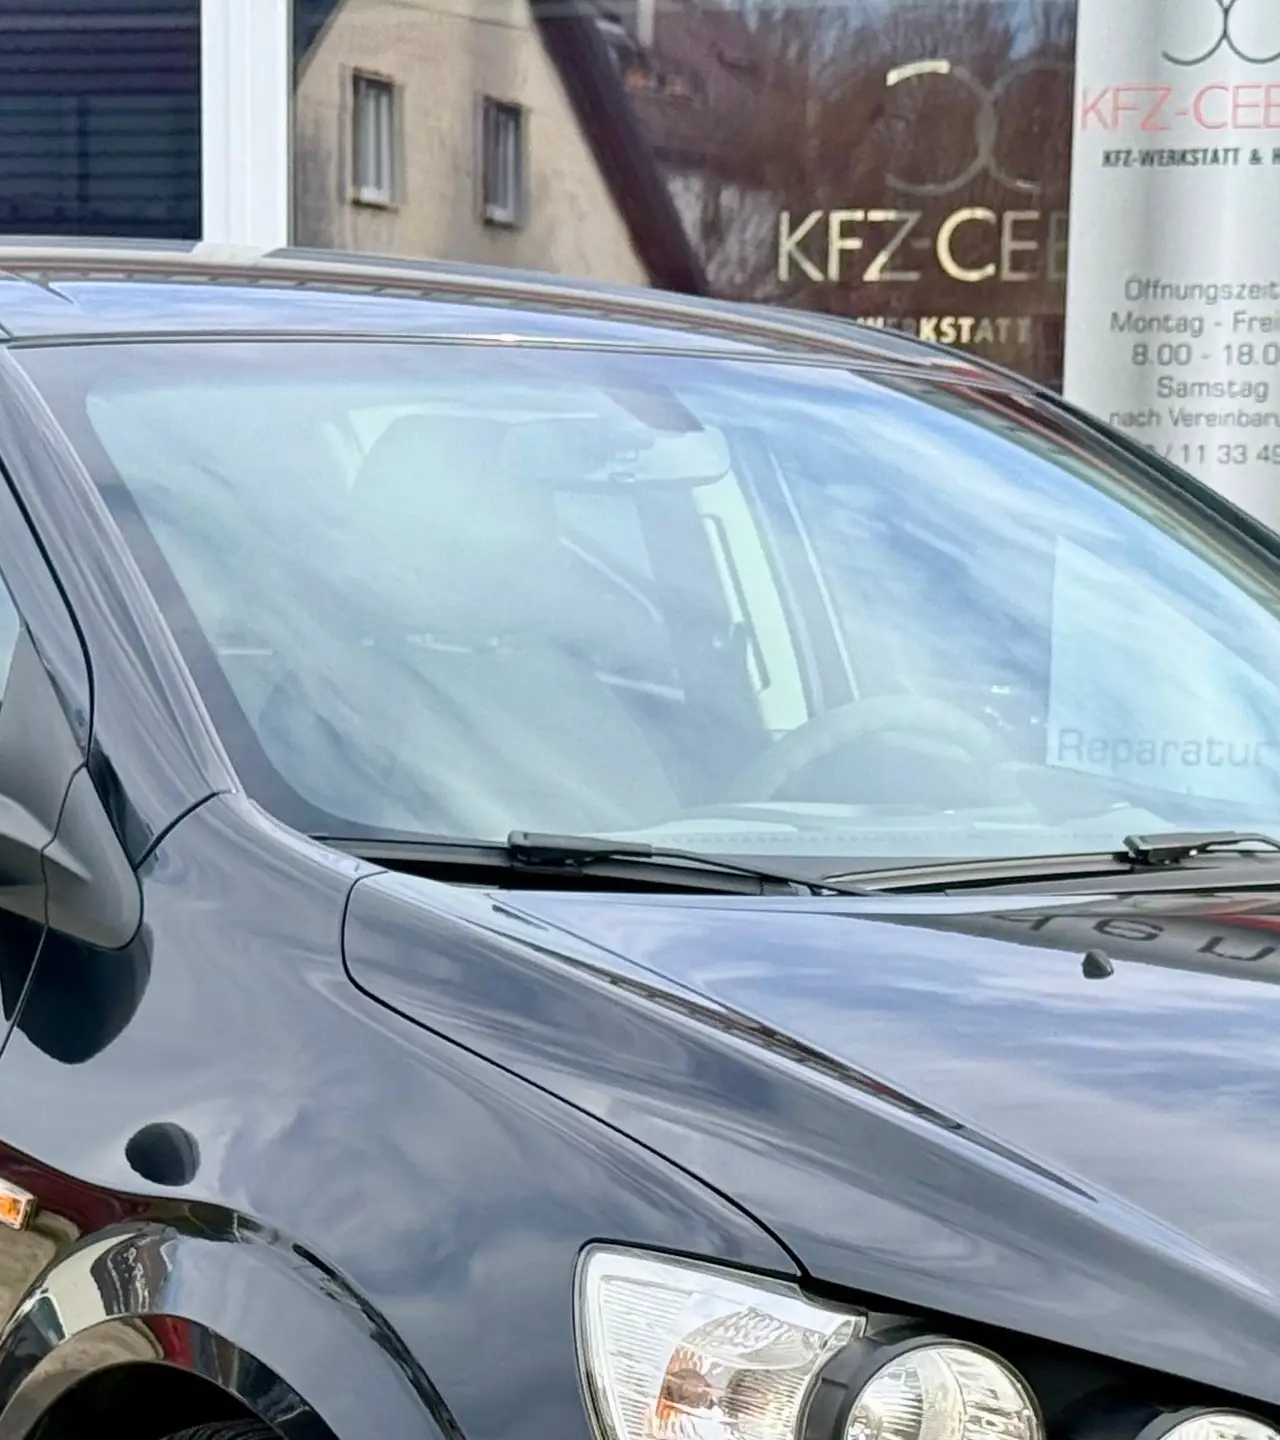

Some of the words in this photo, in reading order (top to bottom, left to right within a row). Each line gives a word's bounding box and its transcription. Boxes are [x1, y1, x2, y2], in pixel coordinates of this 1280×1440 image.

[1101, 149, 1240, 168] KFZ-WERKSTATT
[1248, 149, 1262, 165] &
[1110, 311, 1204, 337] Montag
[1131, 343, 1192, 365] 8.00
[1157, 376, 1269, 402] Samstag
[1109, 410, 1161, 428] nach
[1182, 445, 1206, 463] 11
[1217, 445, 1247, 464] 33
[1058, 728, 1280, 770] Reparatur
